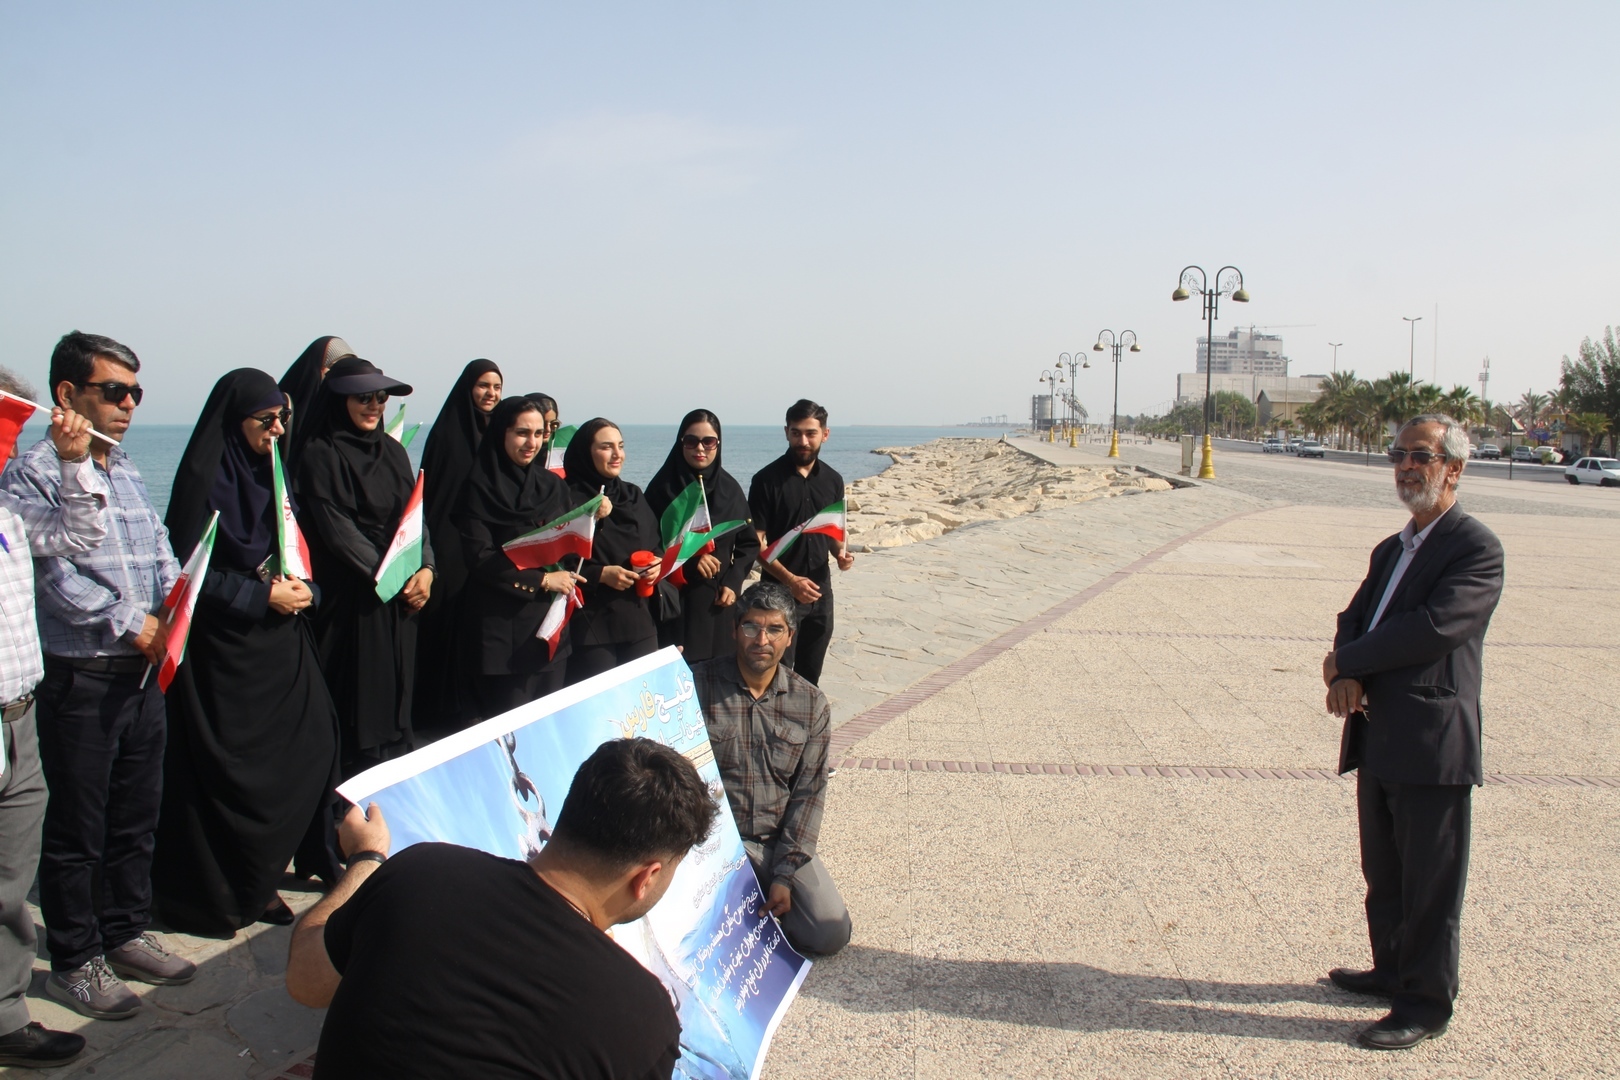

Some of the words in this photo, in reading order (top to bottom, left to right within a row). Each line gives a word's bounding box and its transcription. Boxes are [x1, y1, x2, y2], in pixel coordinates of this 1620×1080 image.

[620, 681, 656, 738] فارس
[654, 671, 694, 724] خلیج
[686, 708, 706, 741] گین
[746, 888, 759, 914] خلیج
